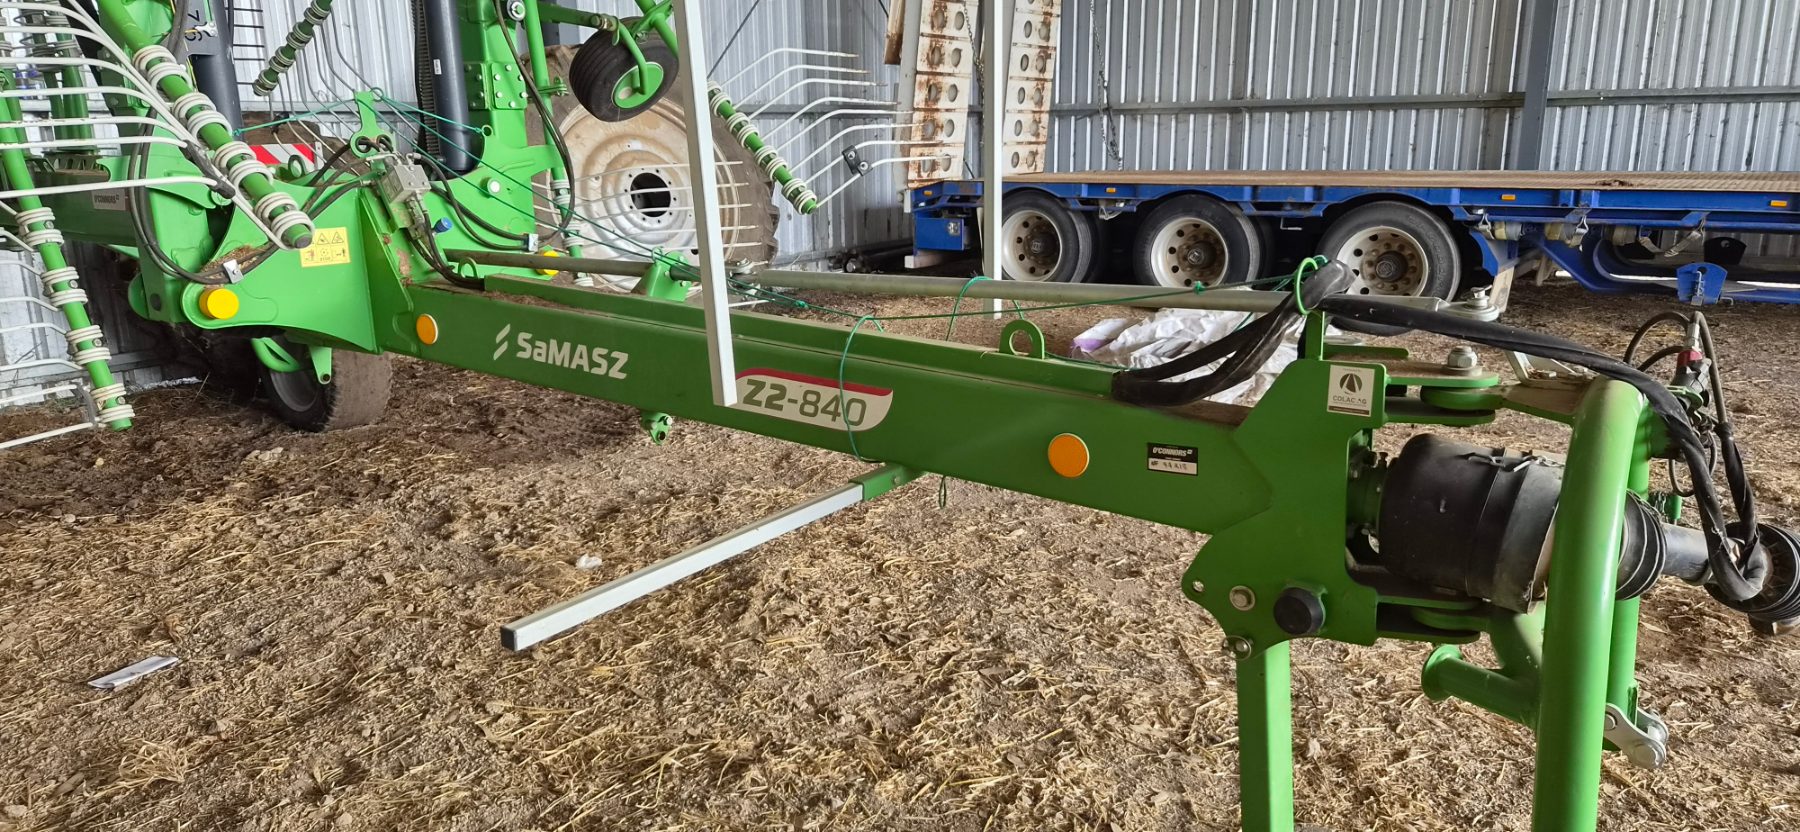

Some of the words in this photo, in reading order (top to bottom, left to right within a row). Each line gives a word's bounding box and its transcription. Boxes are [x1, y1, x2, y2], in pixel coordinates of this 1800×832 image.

[516, 331, 629, 380] SaMASZ
[743, 378, 867, 428] Z2-840
[1332, 395, 1356, 404] COLAC
[1152, 446, 1187, 457] O'CONNORS
